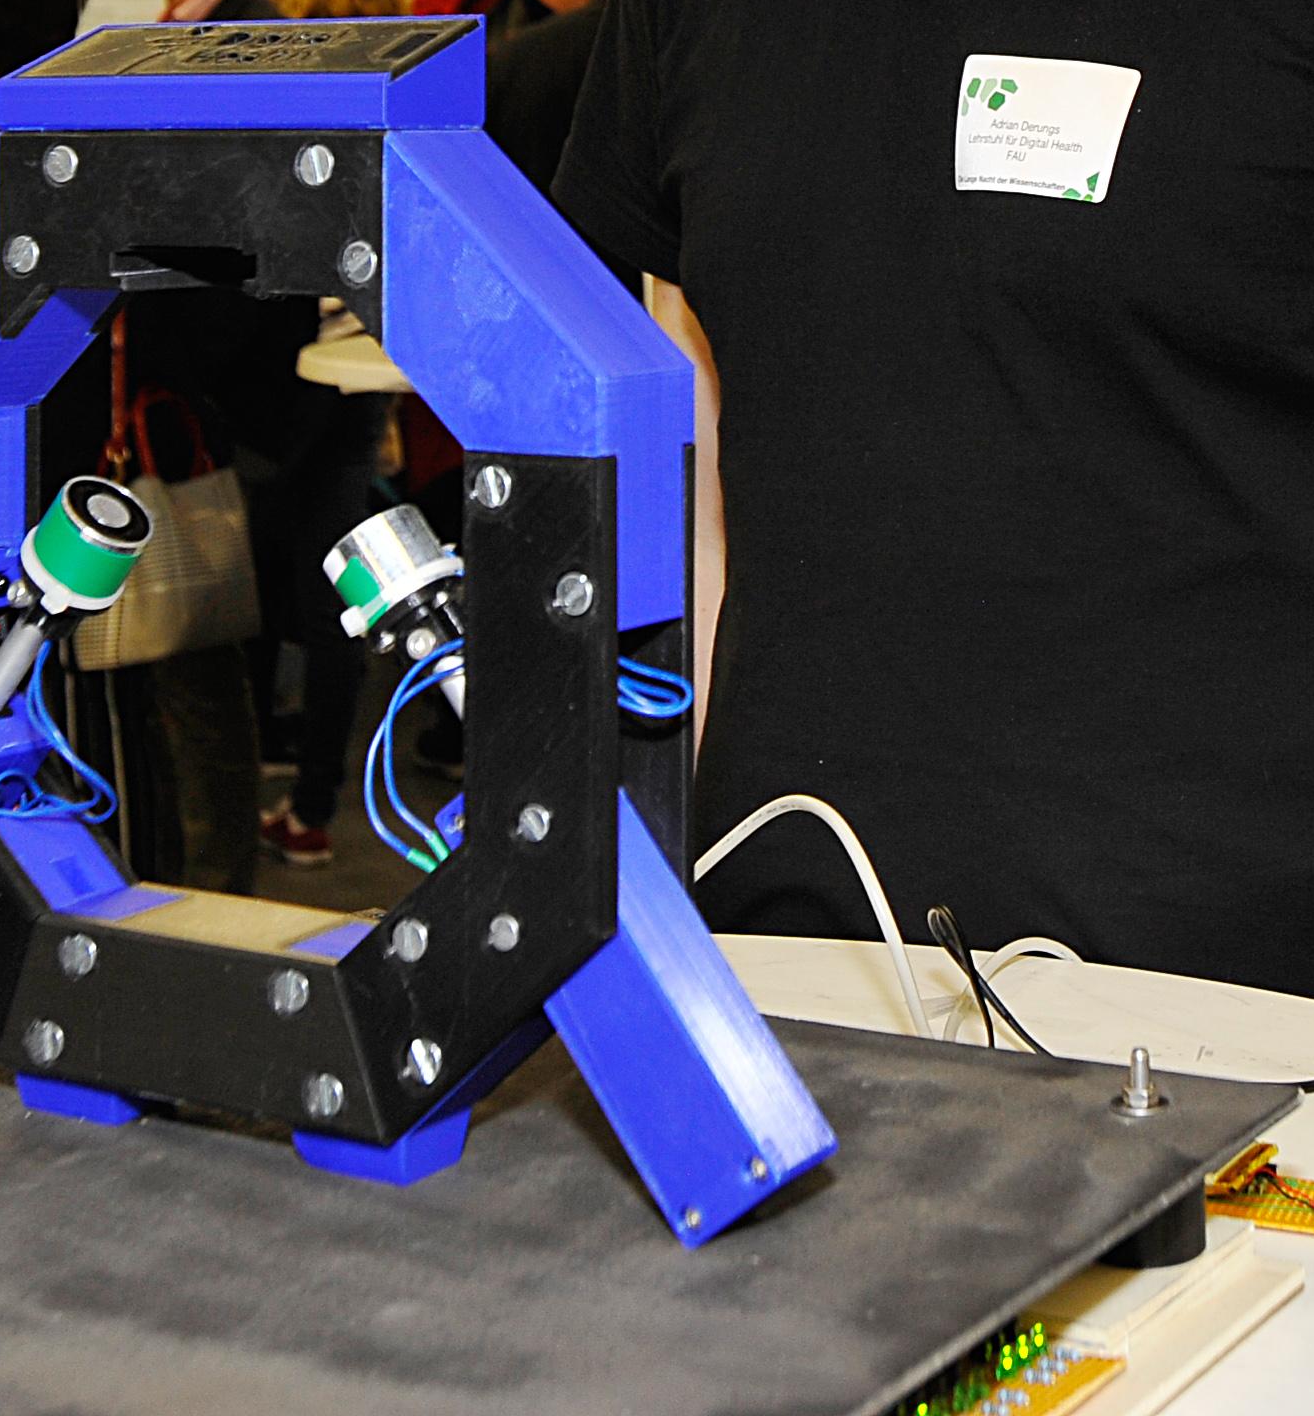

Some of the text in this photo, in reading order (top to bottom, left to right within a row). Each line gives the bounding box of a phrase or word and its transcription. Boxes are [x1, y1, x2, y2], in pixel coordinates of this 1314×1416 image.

[990, 119, 1061, 137] Adrian Derungs
[968, 133, 1084, 153] Lehrstuhl für Digital Health
[1006, 149, 1027, 163] FAU
